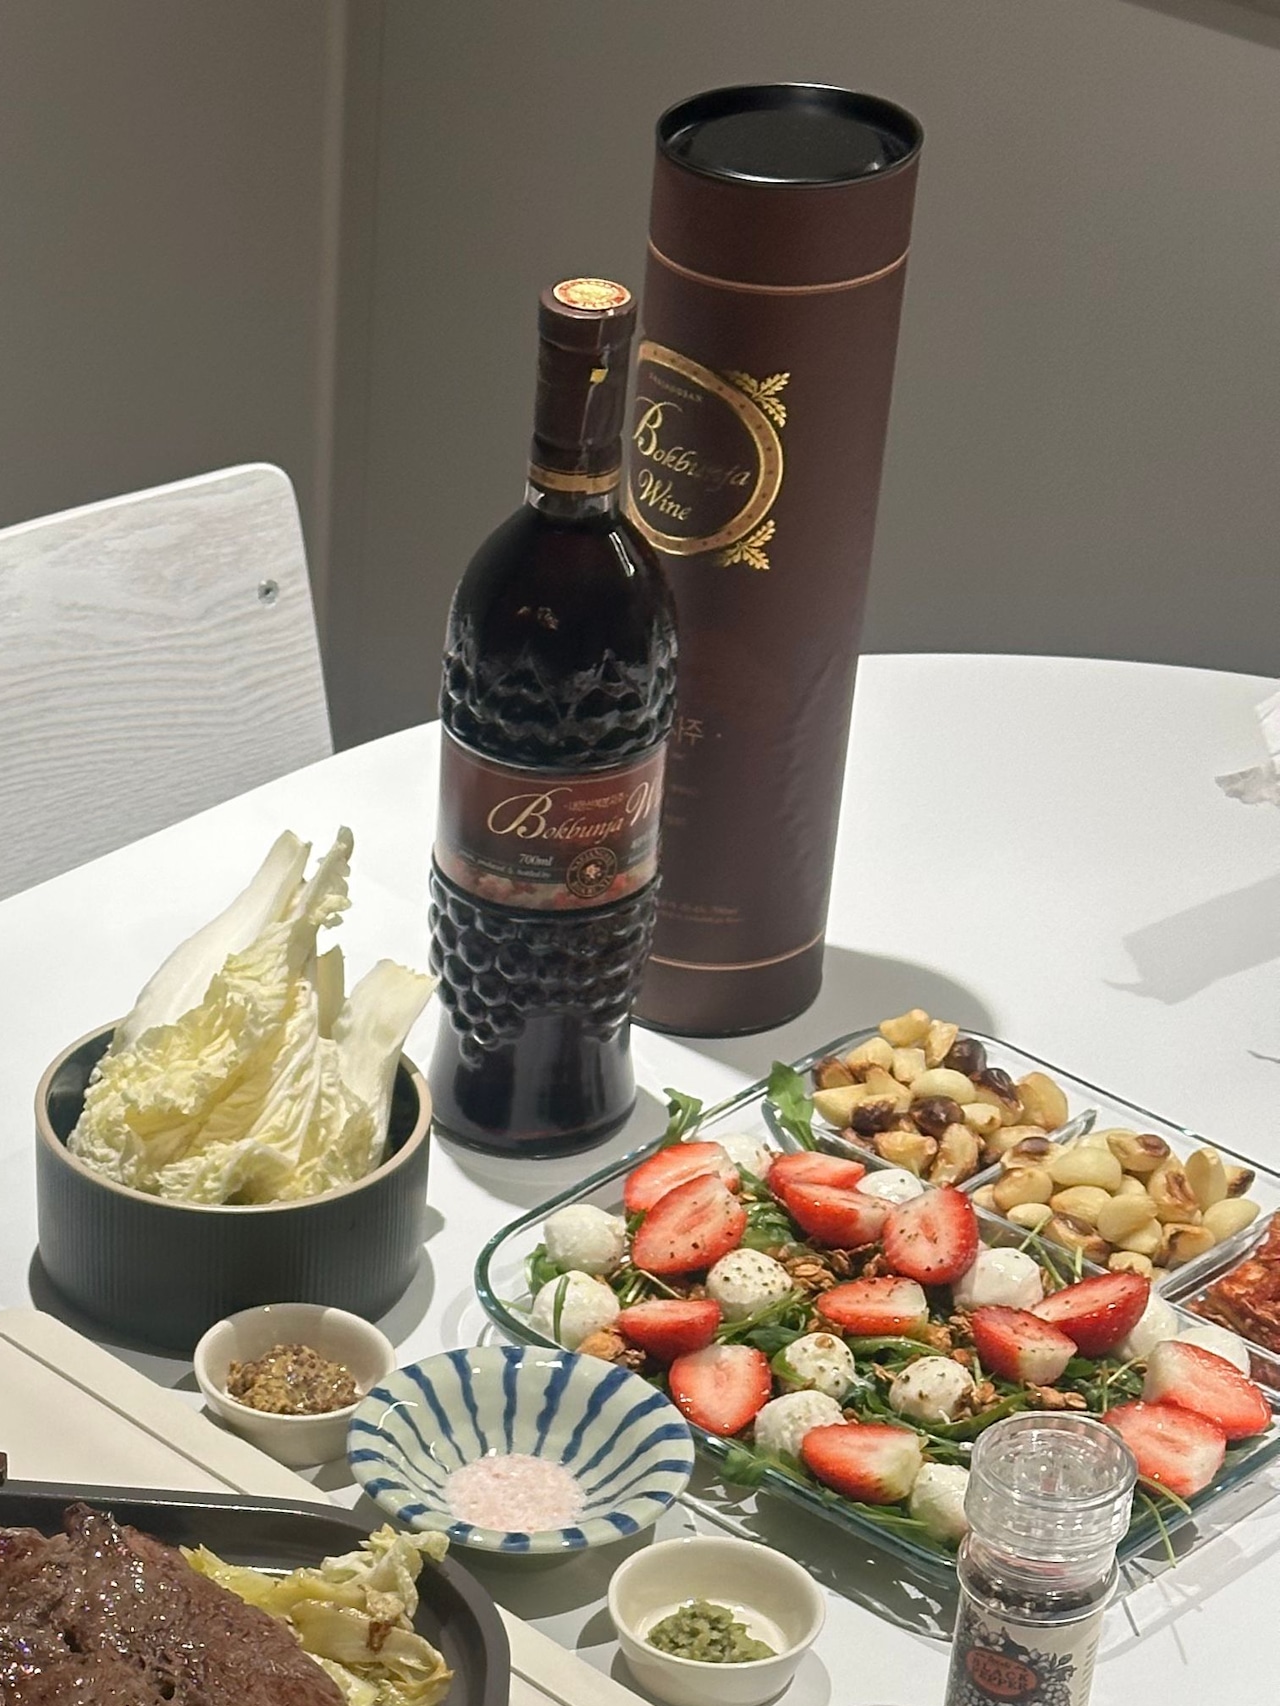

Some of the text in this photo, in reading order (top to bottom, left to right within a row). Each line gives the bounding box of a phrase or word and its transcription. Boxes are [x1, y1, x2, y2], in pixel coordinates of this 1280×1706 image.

[639, 469, 692, 521] Wine
[487, 787, 625, 844] Bokbunja
[519, 853, 554, 867] 700ml
